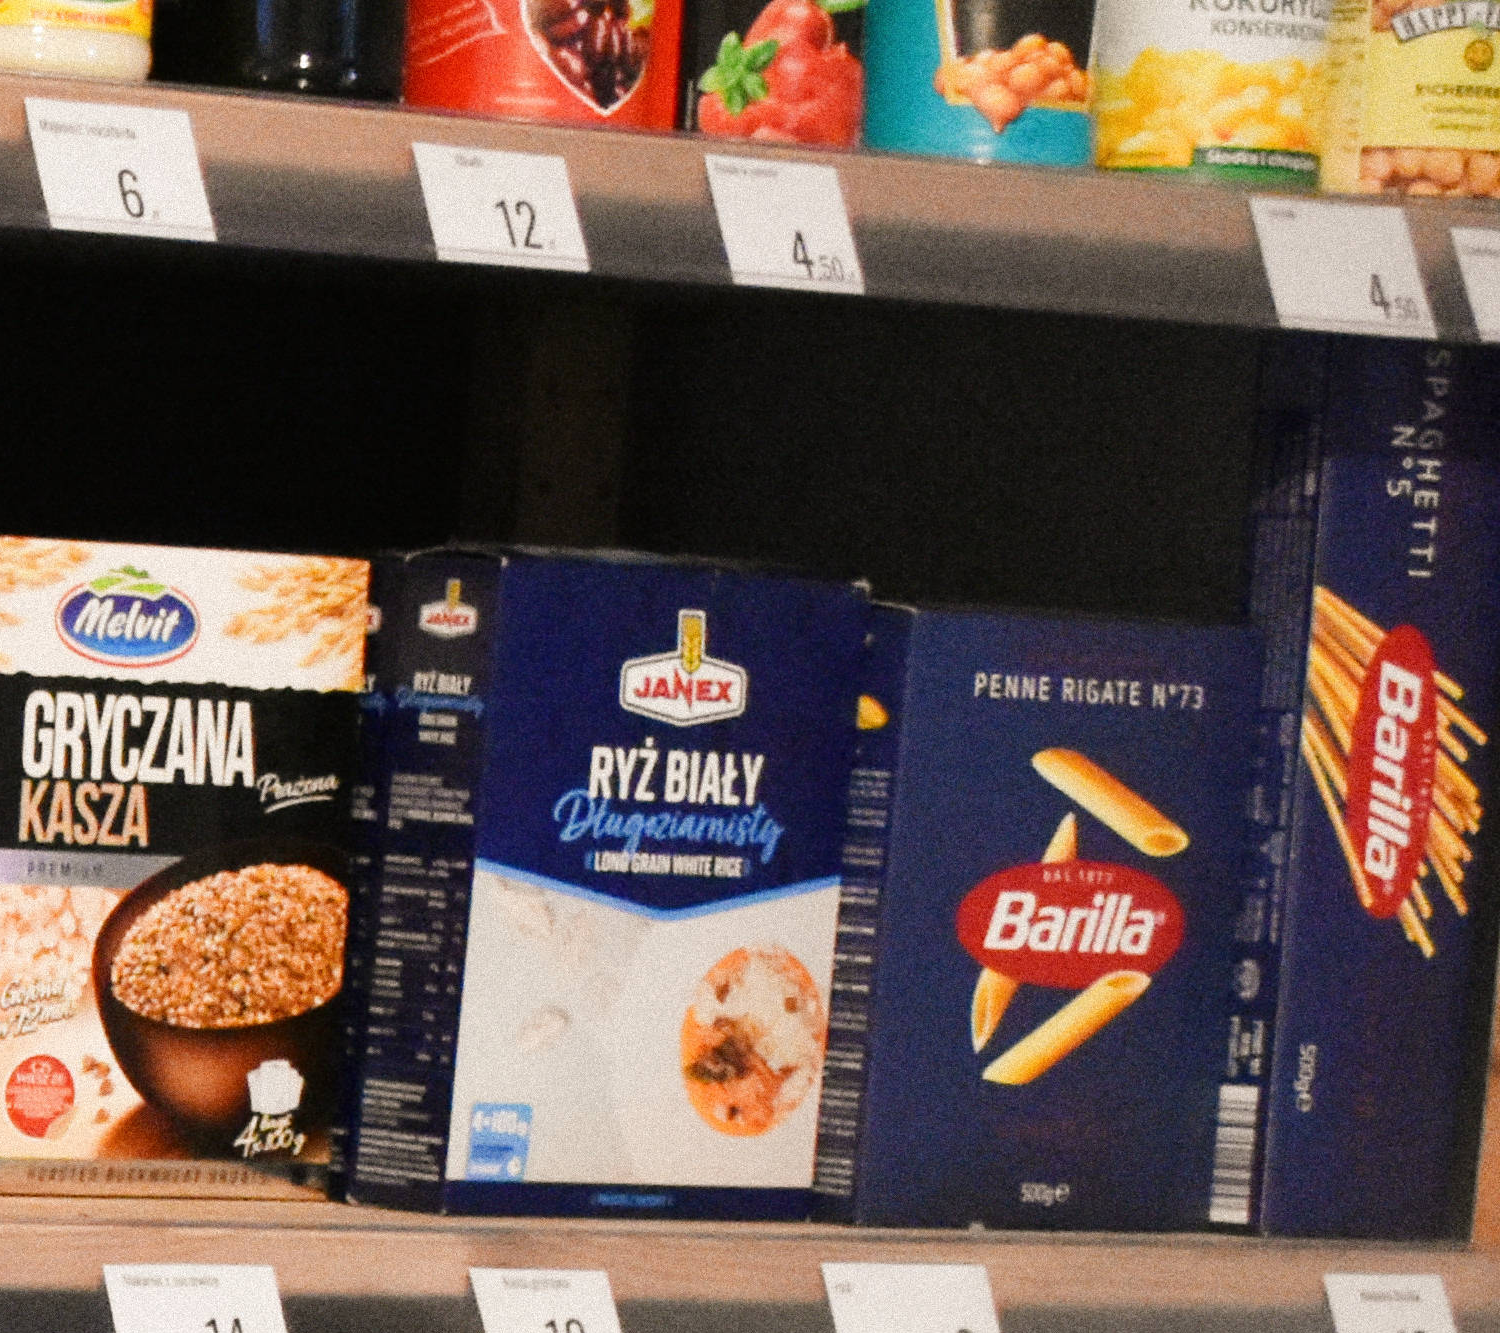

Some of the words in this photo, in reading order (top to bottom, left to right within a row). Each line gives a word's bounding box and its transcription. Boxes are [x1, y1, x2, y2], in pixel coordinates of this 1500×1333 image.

[117, 168, 146, 219] 6
[495, 199, 543, 250] 12
[1407, 349, 1450, 578] SPAGHETTI
[74, 596, 181, 644] Melvit
[632, 667, 733, 708] JANEX
[973, 671, 1052, 702] PENNE
[1062, 675, 1144, 707] RIGATE
[21, 689, 256, 788] GRYCZANA
[588, 736, 658, 802] RYŻ
[664, 749, 765, 806] BIAŁY
[1363, 658, 1425, 888] Barilla
[18, 778, 150, 848] KASZA
[553, 788, 785, 864] Długoziarnisty
[982, 890, 1160, 956] Barilla
